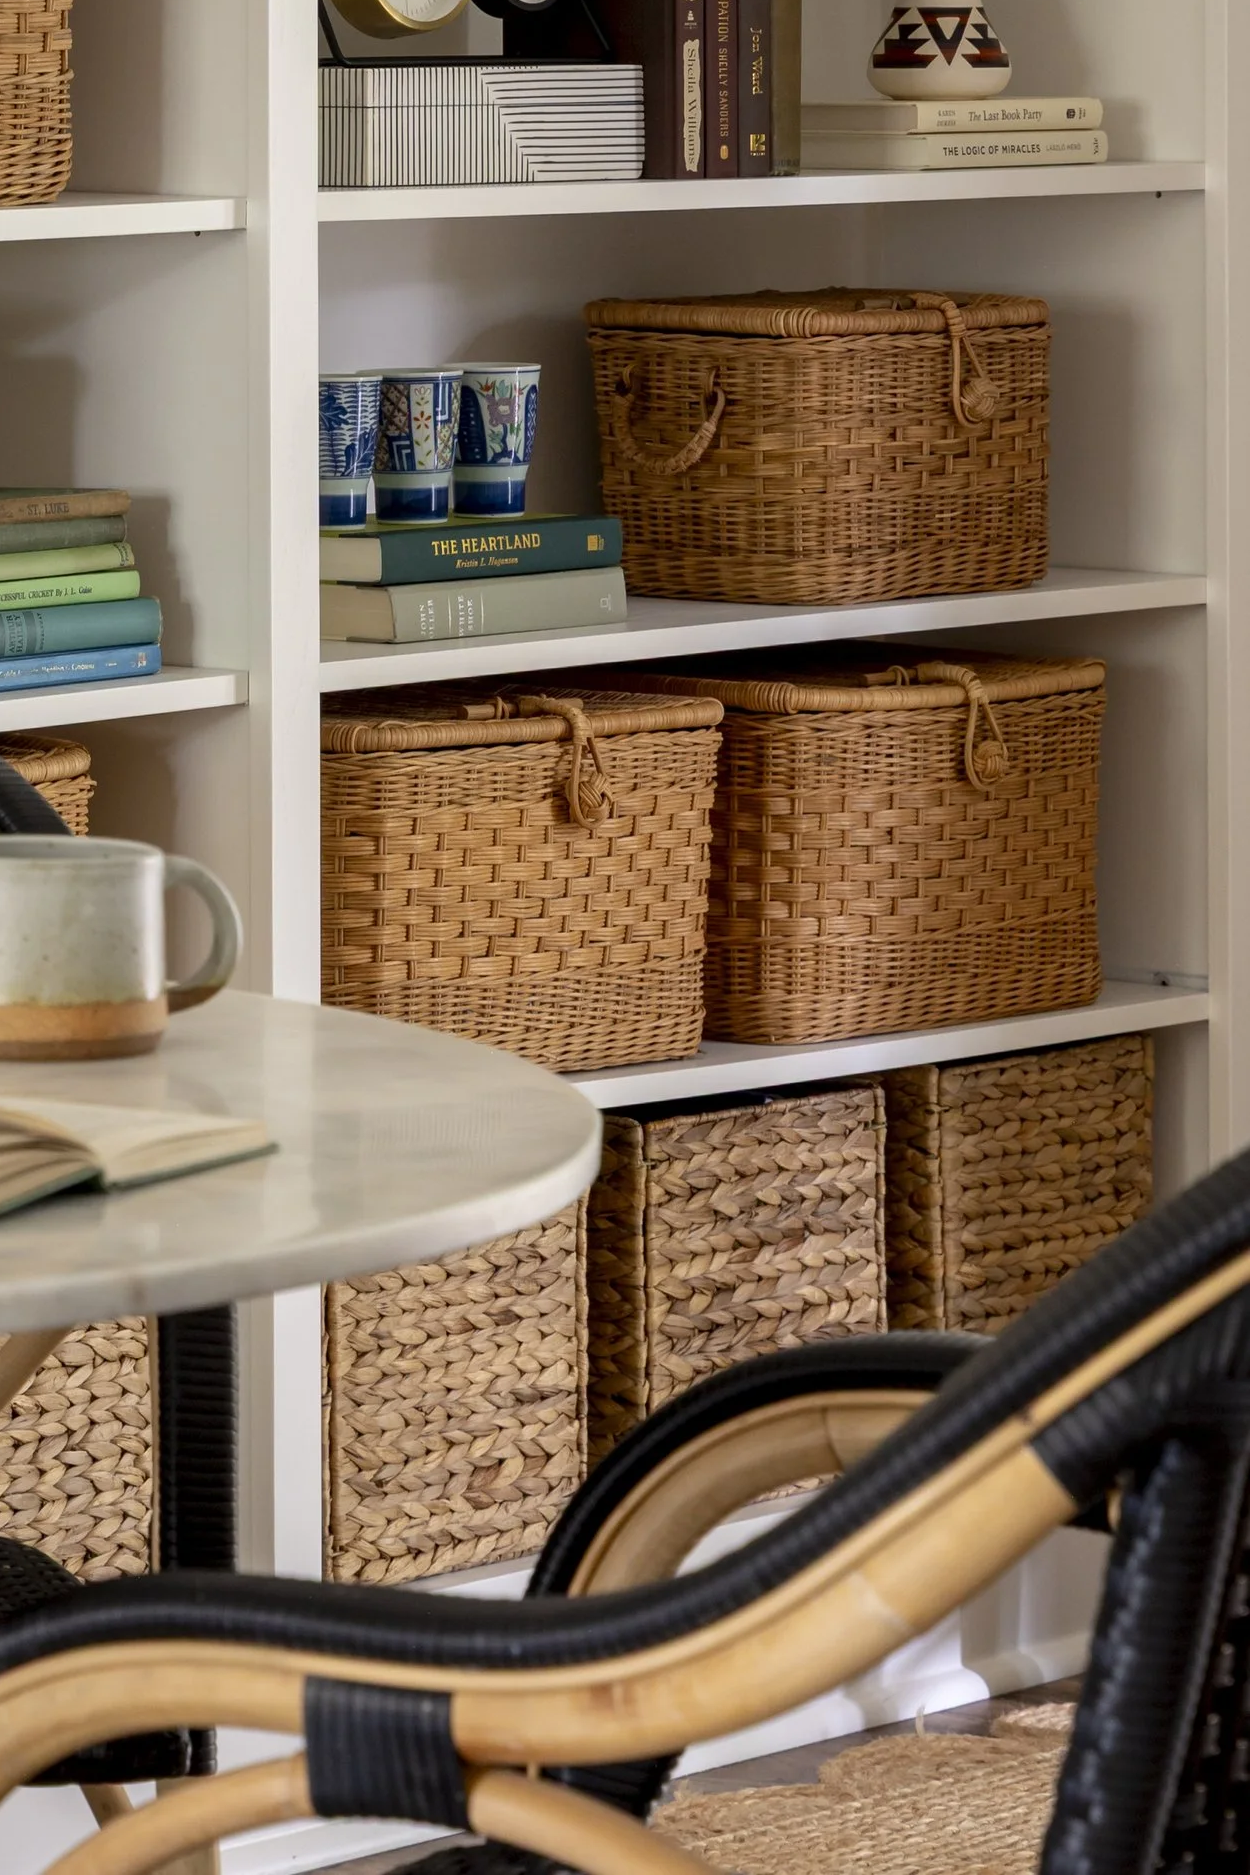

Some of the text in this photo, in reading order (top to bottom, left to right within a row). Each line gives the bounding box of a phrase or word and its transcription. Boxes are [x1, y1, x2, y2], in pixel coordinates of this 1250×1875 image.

[718, 48, 729, 86] SHELLY
[750, 27, 764, 95] Jon Ward
[686, 47, 698, 166] Sheila Williams
[719, 90, 729, 137] SANDERS
[968, 108, 1043, 122] The Last Book Party
[943, 144, 1041, 156] THE LOGIC OF MIRACLES
[26, 503, 41, 516] ST.
[44, 502, 70, 515] LUKE
[431, 533, 541, 556] THE HEARTLAND
[455, 557, 479, 569] Kristin
[480, 557, 486, 567] L.
[28, 589, 54, 599] CRICKET
[55, 588, 63, 598] By
[6, 614, 16, 653] ARTHUR
[13, 615, 23, 654] HAILEY
[419, 604, 427, 636] JOHN
[427, 599, 435, 639] OLLER
[457, 595, 465, 637] WHITE
